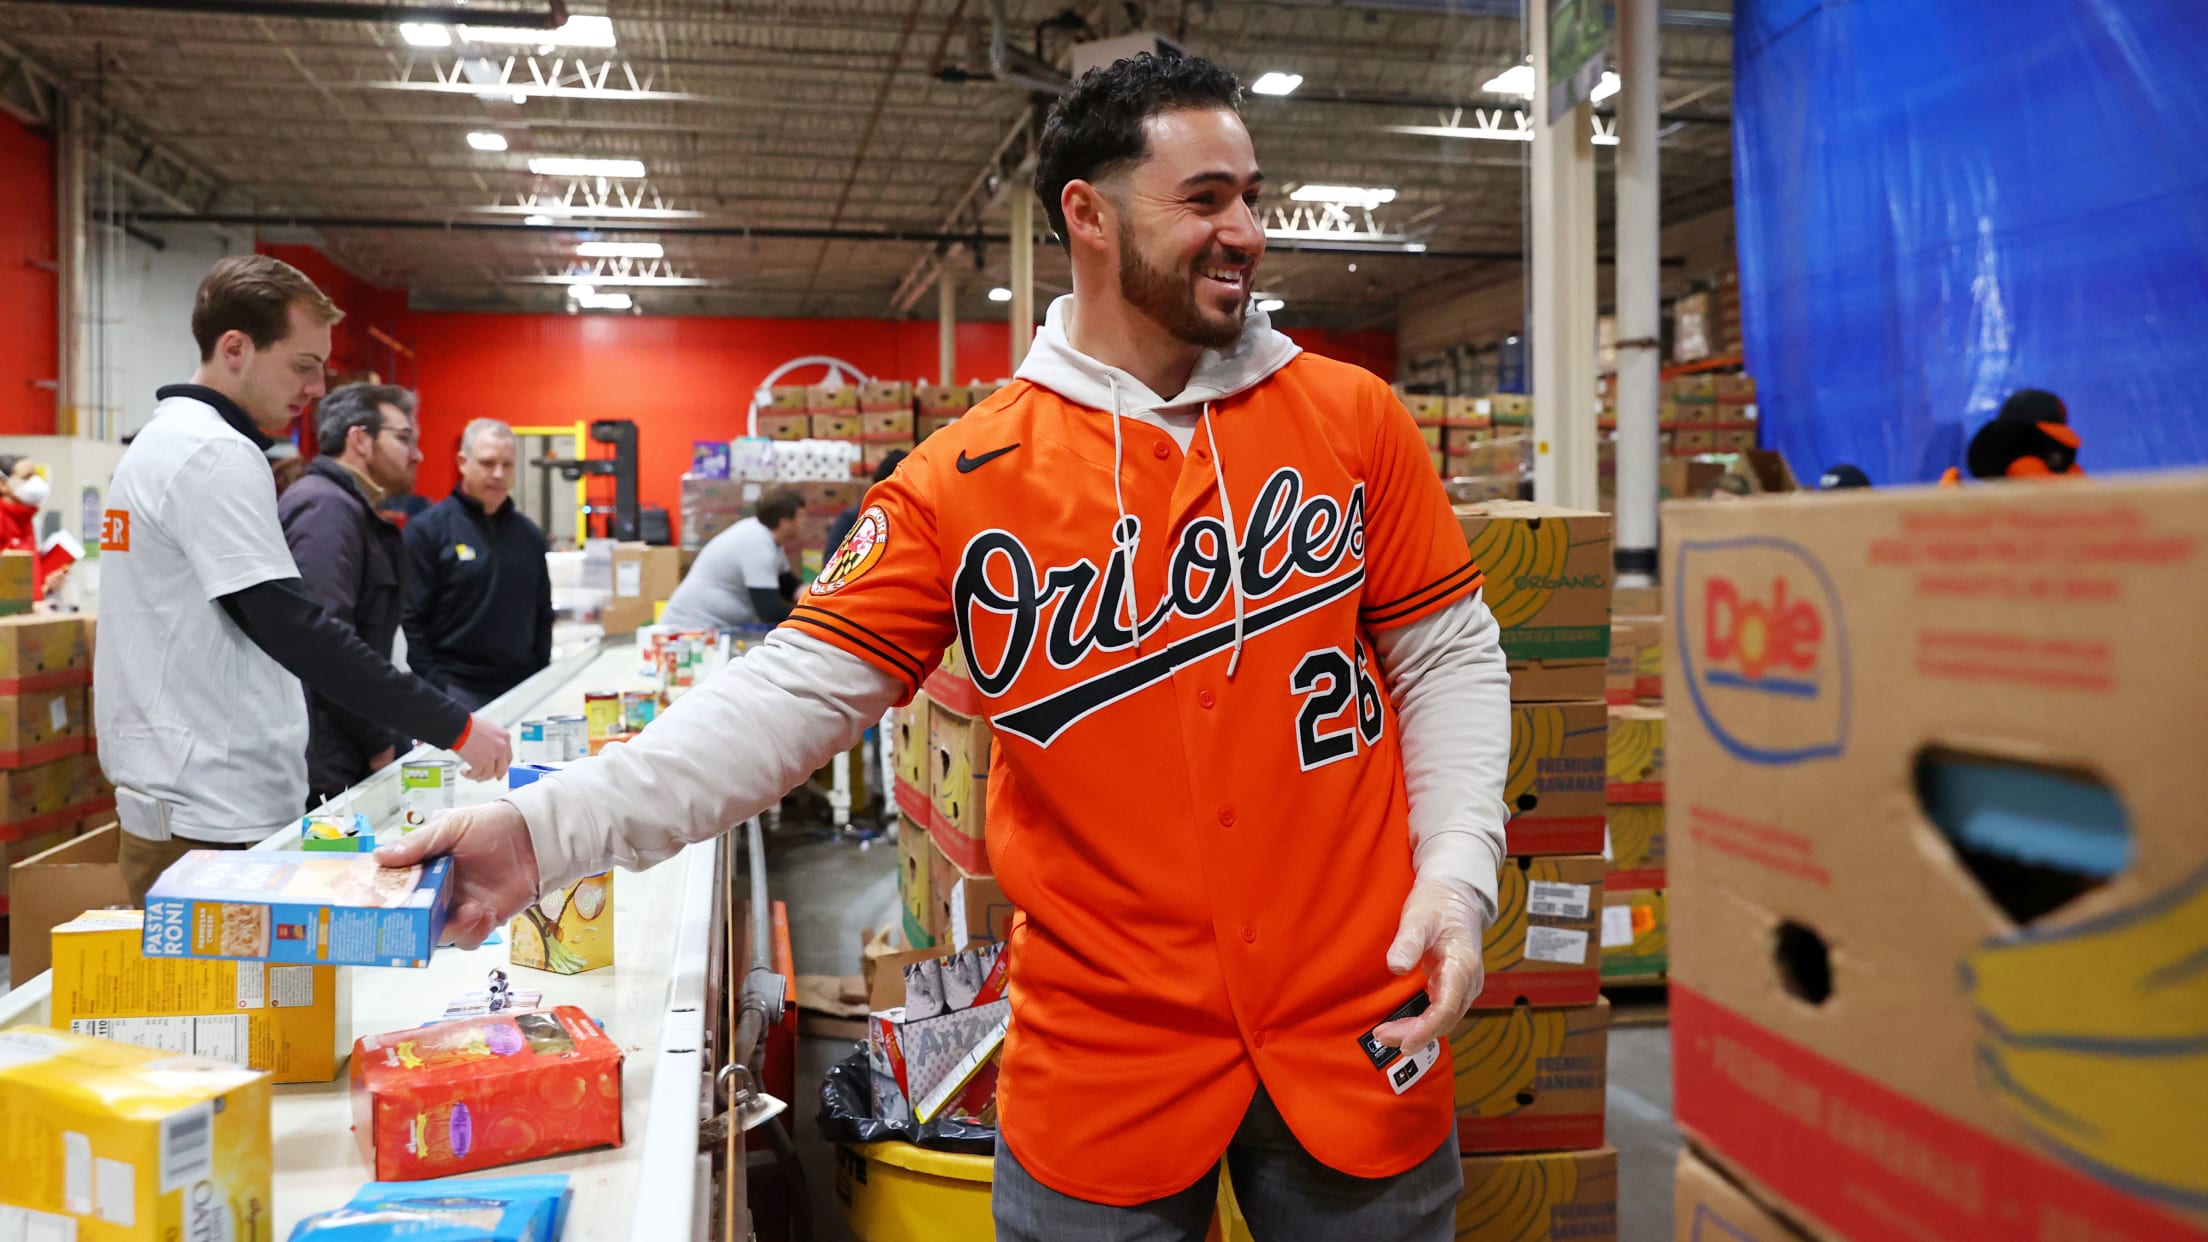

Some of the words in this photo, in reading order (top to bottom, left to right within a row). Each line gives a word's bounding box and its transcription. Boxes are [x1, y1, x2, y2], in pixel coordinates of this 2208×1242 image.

[100, 516, 125, 544] ER
[952, 466, 1366, 698] Orioles
[1513, 573, 1607, 591] ORGANIC
[1704, 575, 1825, 680] Dole
[1289, 637, 1384, 772] 26
[146, 902, 164, 954] PASTA
[164, 902, 184, 955] RONI
